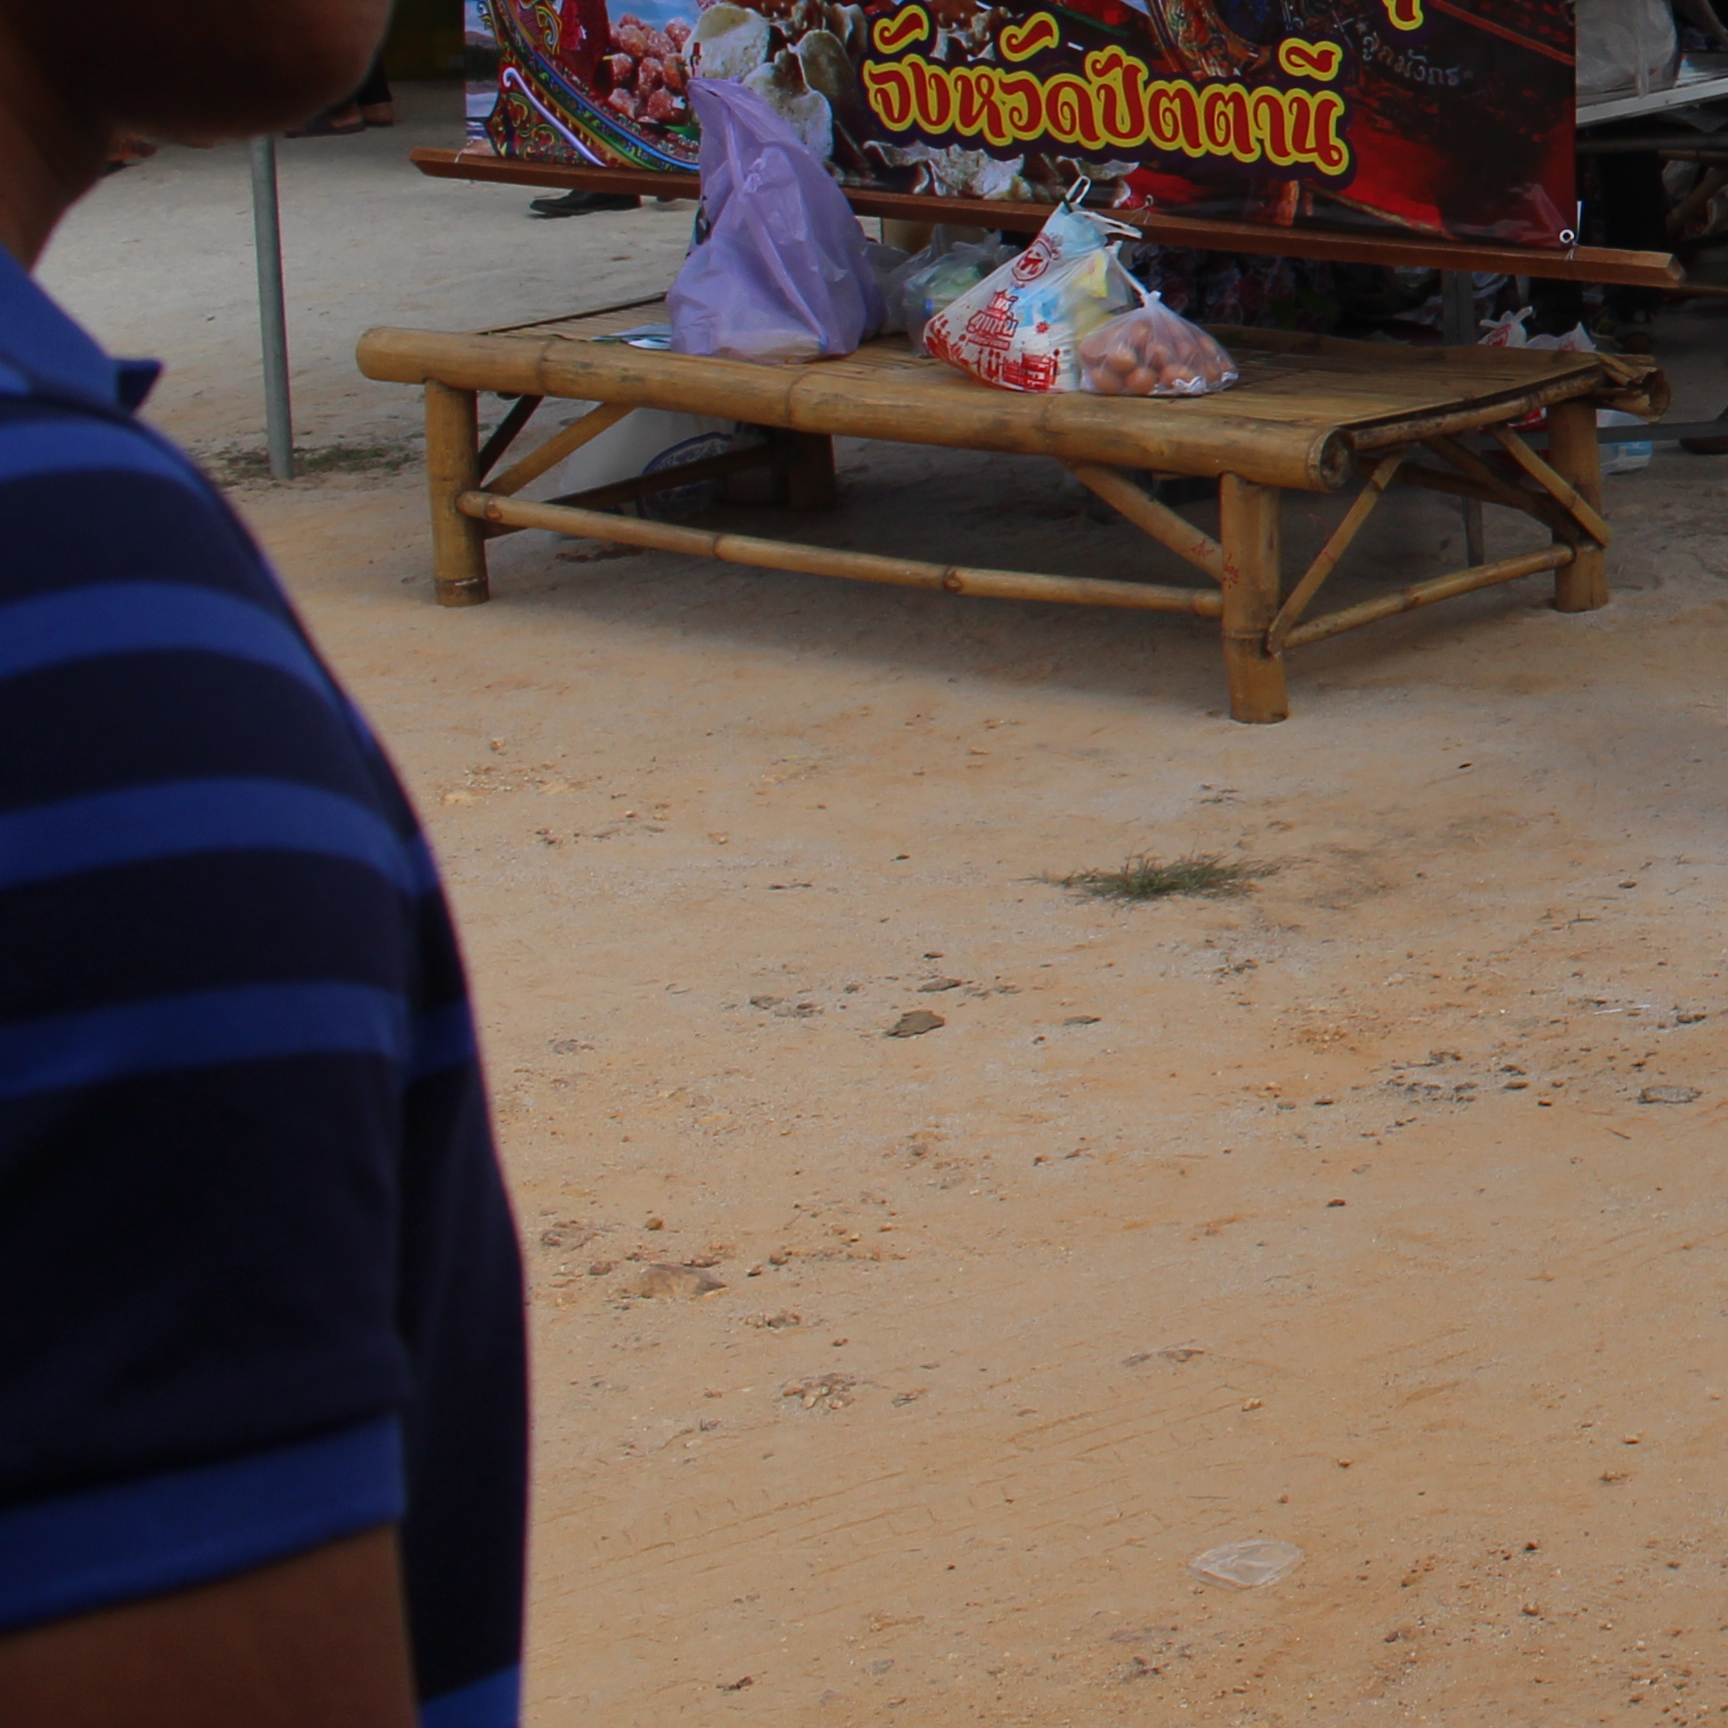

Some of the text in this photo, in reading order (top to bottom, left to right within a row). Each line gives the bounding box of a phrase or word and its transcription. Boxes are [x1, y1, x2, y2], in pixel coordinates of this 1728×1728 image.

[860, 5, 1352, 176] จังหวัดปัตตานี
